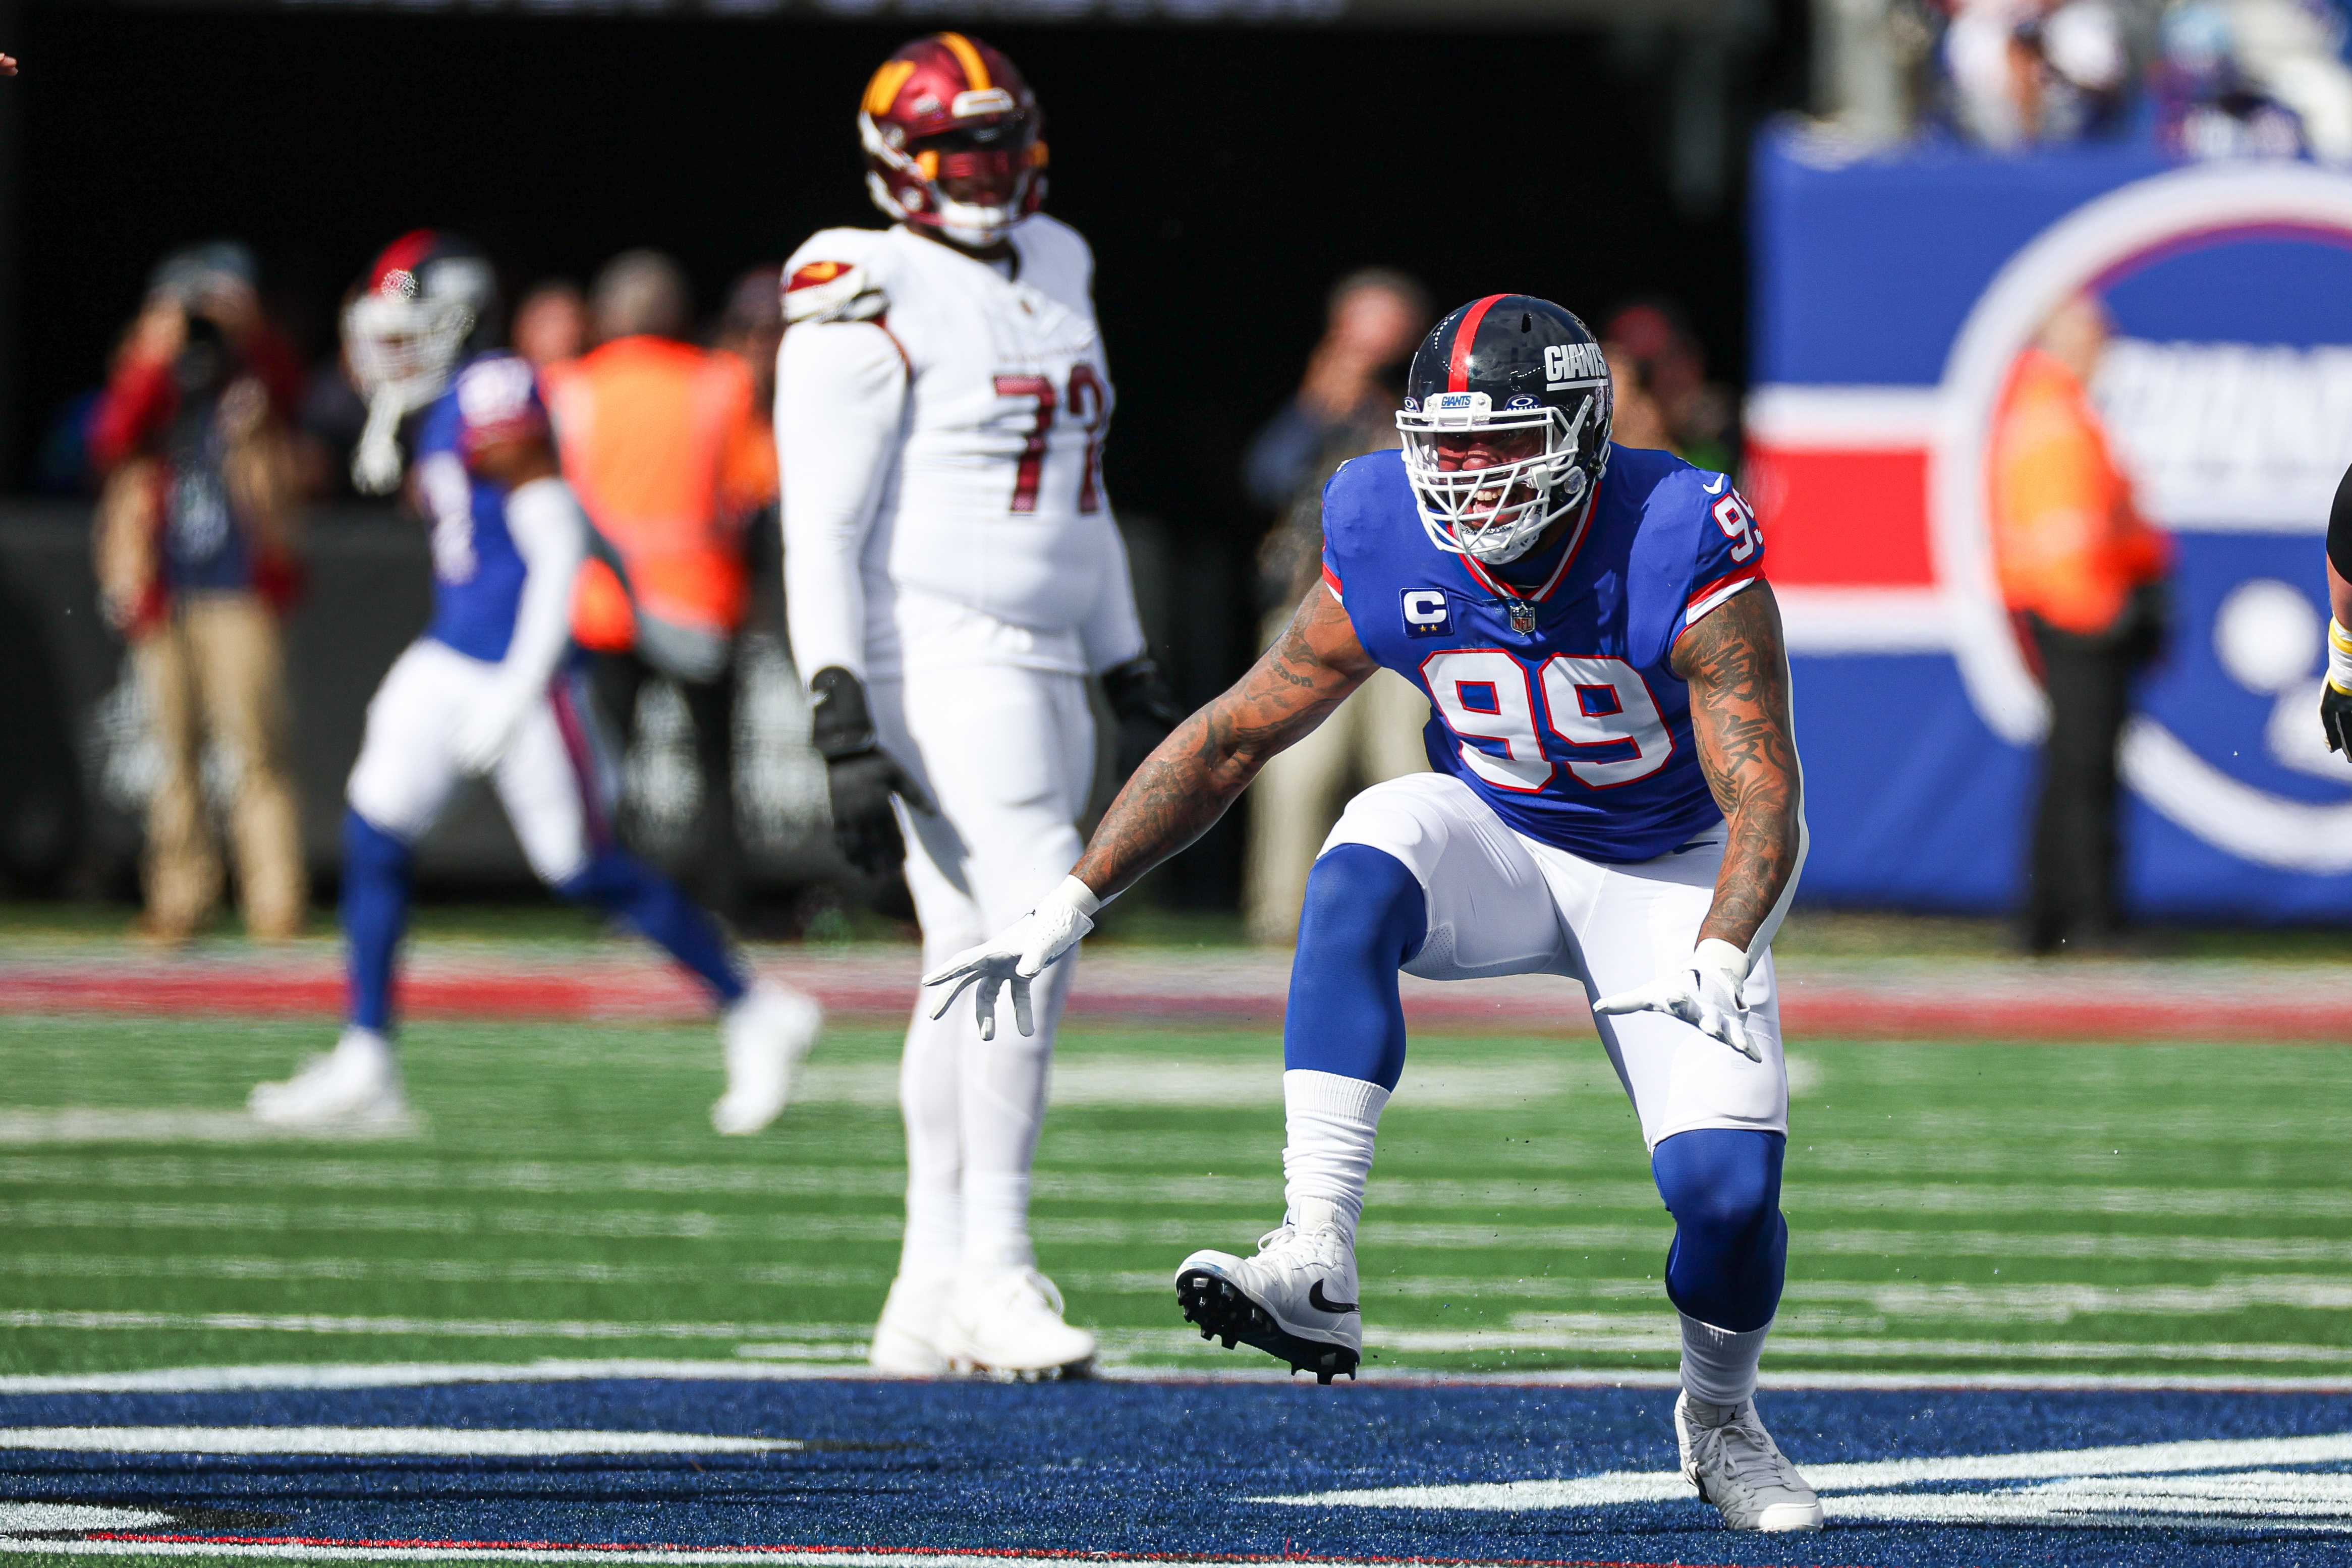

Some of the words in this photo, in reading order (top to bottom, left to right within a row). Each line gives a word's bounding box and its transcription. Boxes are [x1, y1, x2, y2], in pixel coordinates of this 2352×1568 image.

[1544, 343, 1607, 381] GIANTS
[1441, 396, 1472, 406] GIANTS
[1404, 591, 1447, 624] C
[1514, 618, 1532, 631] NFL
[1418, 648, 1677, 794] 99
